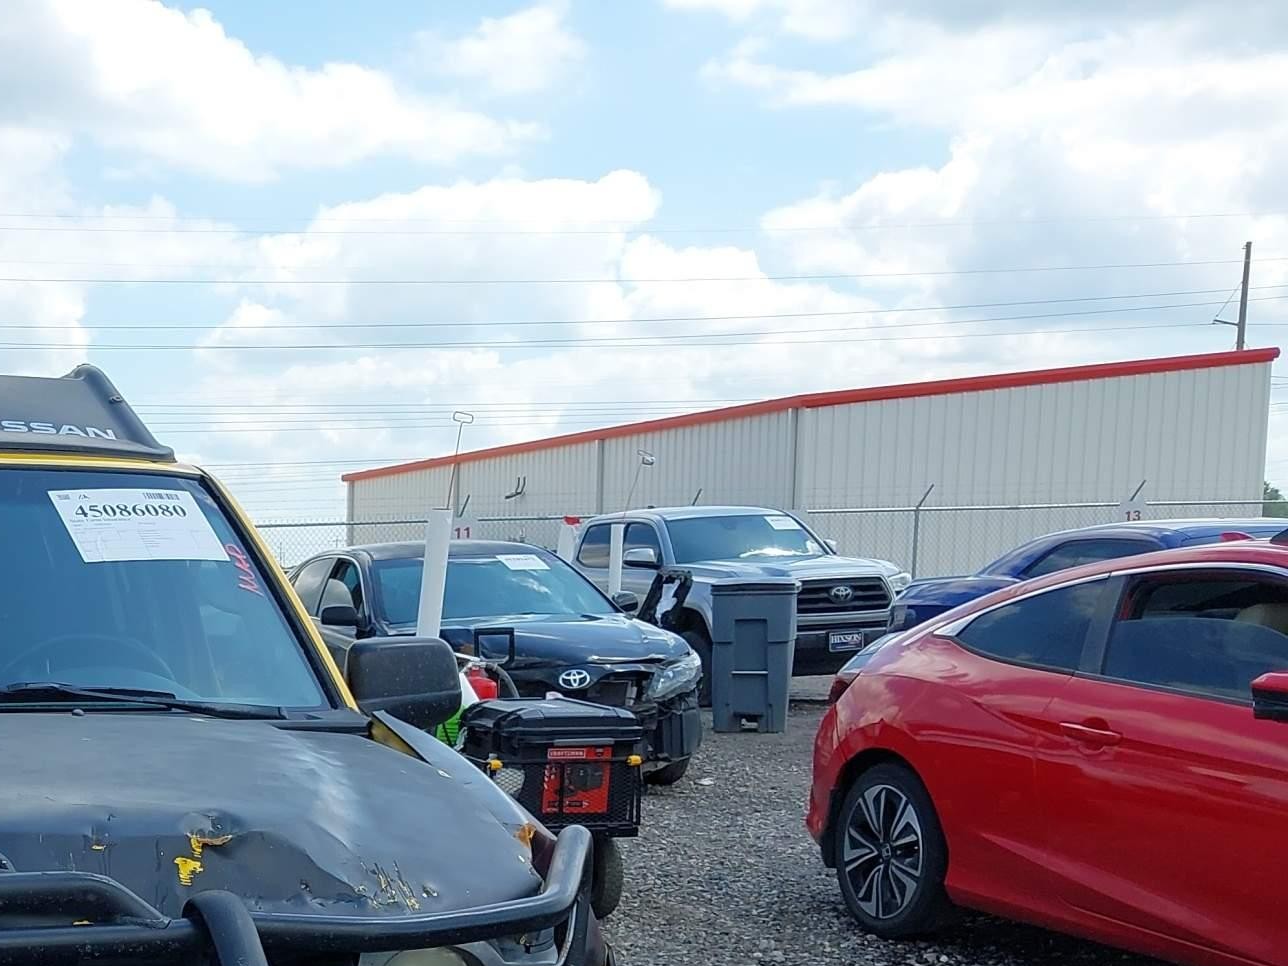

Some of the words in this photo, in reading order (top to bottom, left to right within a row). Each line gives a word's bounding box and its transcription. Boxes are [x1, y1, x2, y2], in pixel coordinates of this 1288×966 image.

[75, 503, 187, 518] 45086080
[1125, 510, 1141, 521] 13
[454, 526, 470, 539] 11
